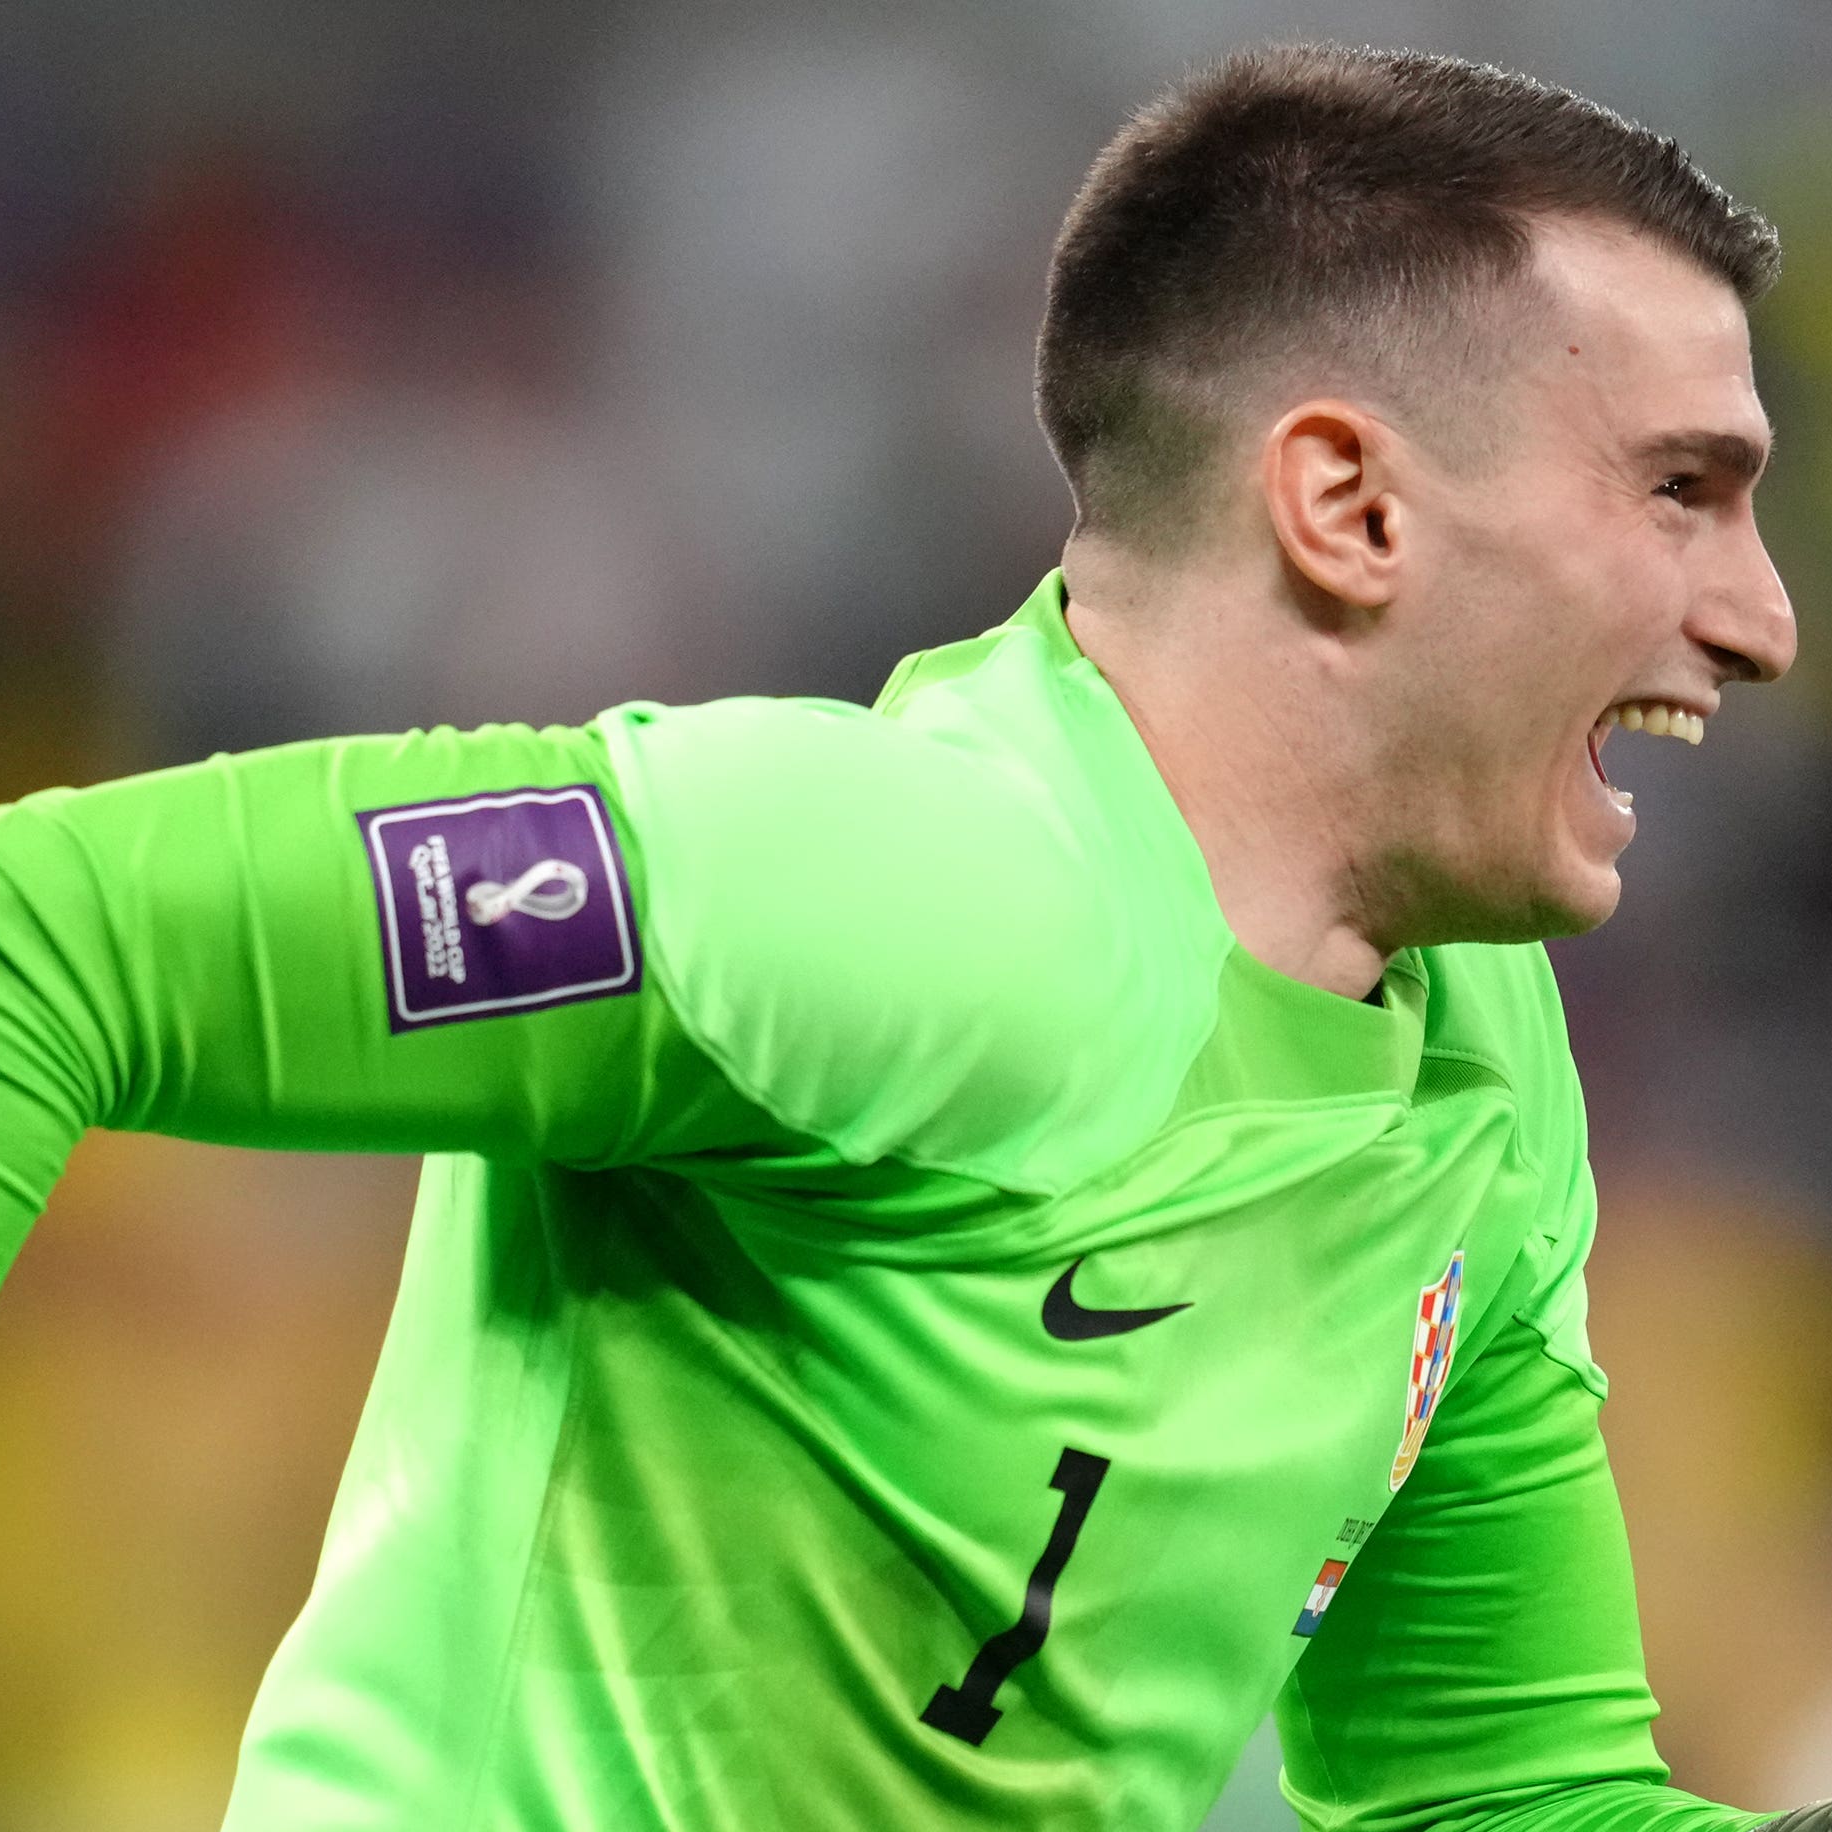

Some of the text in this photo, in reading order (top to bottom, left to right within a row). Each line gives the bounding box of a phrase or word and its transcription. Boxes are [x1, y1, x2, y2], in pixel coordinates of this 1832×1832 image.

[437, 876, 461, 945] WORLD
[447, 945, 466, 985] CUP
[919, 1448, 1110, 1747] 1
